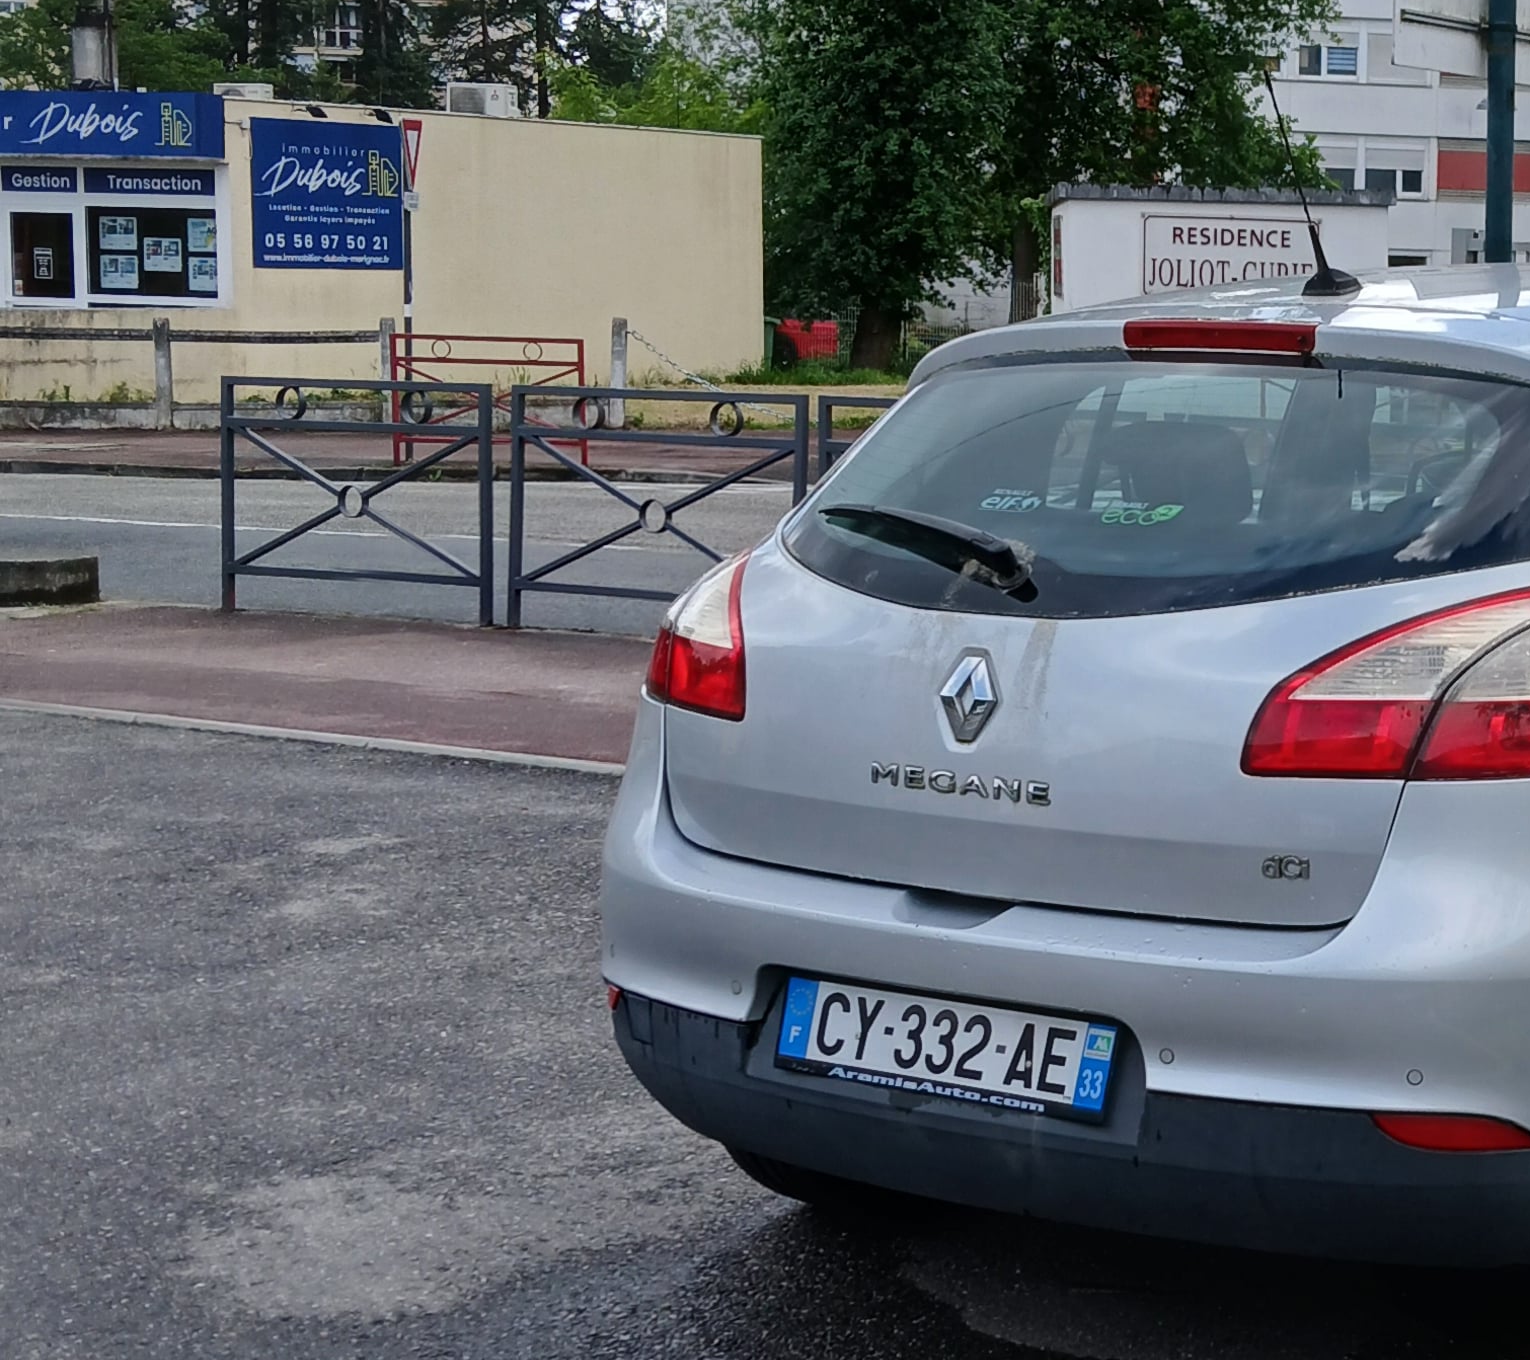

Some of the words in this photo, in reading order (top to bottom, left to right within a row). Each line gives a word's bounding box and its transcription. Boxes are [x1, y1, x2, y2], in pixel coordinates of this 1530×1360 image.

[19, 102, 143, 144] Dubois
[12, 173, 70, 189] Gestion
[107, 175, 202, 191] Transaction
[253, 156, 366, 197] Dubois
[269, 204, 302, 212] Location
[310, 205, 339, 213] Gestion
[346, 206, 390, 214] Transaction
[320, 216, 343, 225] loyers
[265, 233, 286, 248] 05
[321, 235, 339, 249] 97
[346, 235, 366, 250] 50
[373, 236, 388, 250] 21
[1172, 226, 1292, 249] RESIDENCE
[871, 761, 1051, 806] MEGANE
[788, 1025, 802, 1043] F
[816, 992, 1078, 1095] CY-332-AE
[827, 1067, 1045, 1113] AramisAuto.com
[1078, 1068, 1103, 1099] 33
